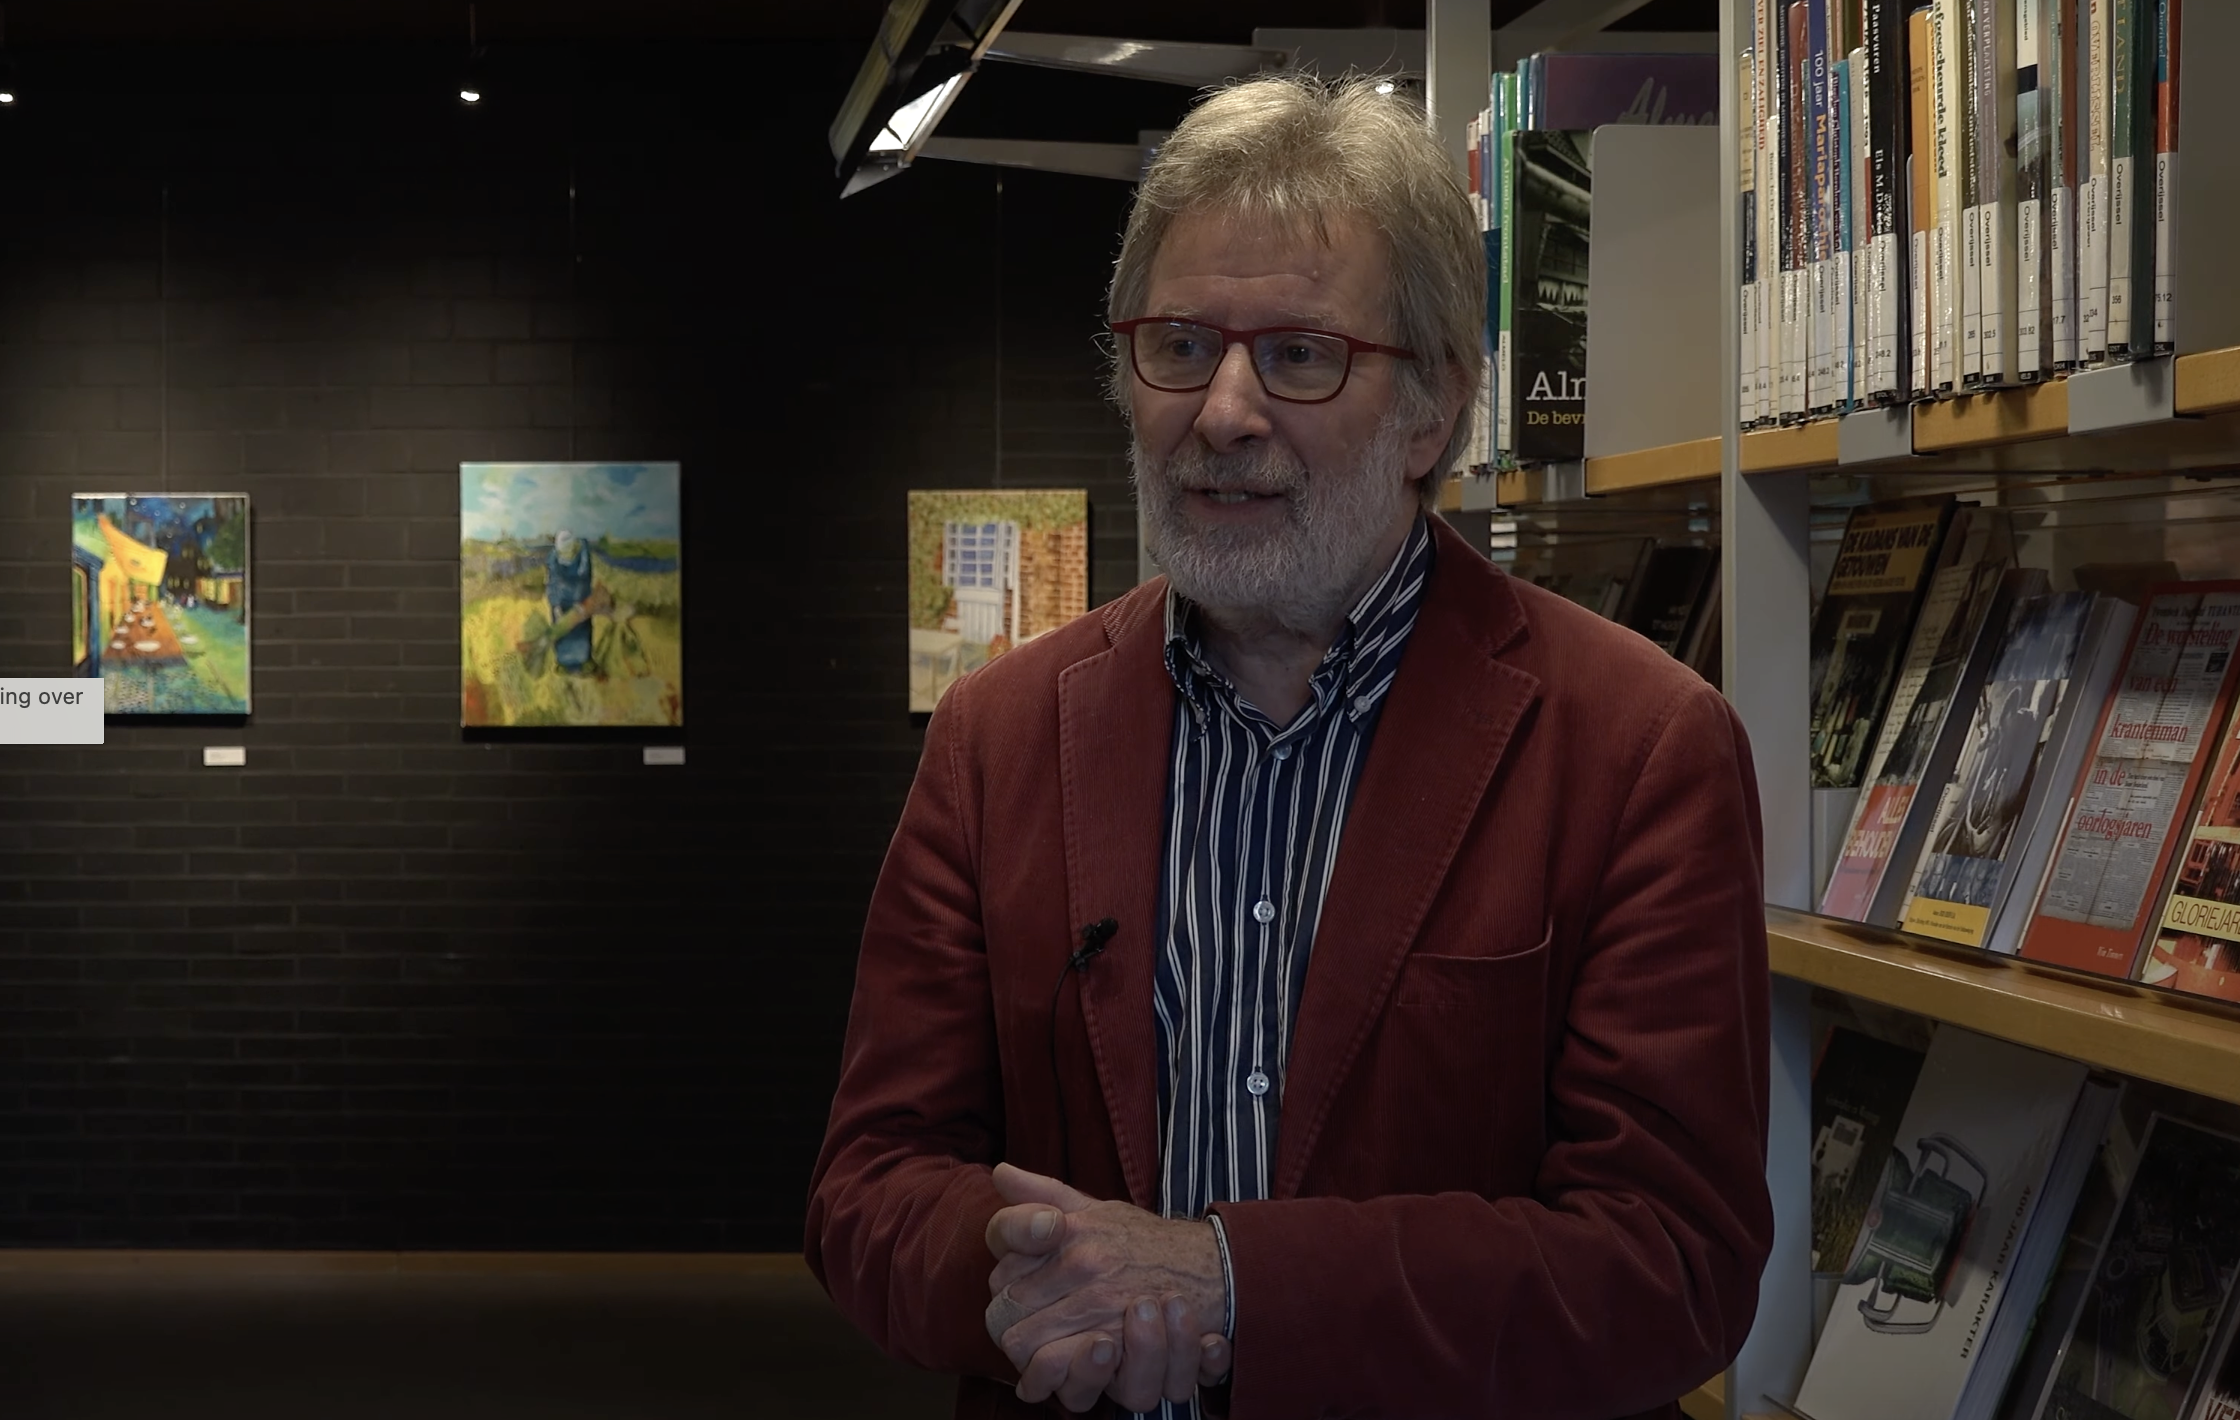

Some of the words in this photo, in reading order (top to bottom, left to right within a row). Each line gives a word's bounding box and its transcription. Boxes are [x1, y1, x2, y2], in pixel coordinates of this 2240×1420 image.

[1871, 4, 1881, 74] Paasvuren
[1982, 16, 1992, 97] VERPLAATSING
[2115, 16, 2126, 95] LAND
[2157, 1, 2167, 58] Overijssel
[1814, 49, 1825, 77] 100
[1933, 1, 1947, 124] afgescheurde
[1812, 80, 1825, 108] jaar
[1874, 148, 1885, 171] Els
[1938, 127, 1948, 178] kleed
[1502, 157, 1511, 211] Almelo
[1814, 113, 1832, 262] Mariaparochie
[2089, 178, 2098, 232] Overijssel
[2115, 163, 2124, 225] Overijssel
[2157, 160, 2166, 223] Overijssel
[1501, 213, 1510, 284] frontstad
[1967, 211, 1976, 268] Overijssel
[1983, 210, 1992, 267] Overijssel
[2022, 205, 2031, 262] Overijssel
[2050, 193, 2060, 250] Overijssel
[1818, 265, 1826, 314] Overijssel
[1878, 240, 1887, 292] Overijssel
[1526, 409, 1549, 425] De
[2142, 621, 2164, 646] De
[2166, 620, 2234, 650] worsteling
[2130, 676, 2152, 692] van
[2154, 677, 2179, 693] een
[2110, 714, 2188, 742] krantenman
[2094, 763, 2108, 785] in
[2109, 762, 2126, 786] de
[2077, 807, 2152, 841] oorlogsjaren
[2015, 1184, 2031, 1218] 400
[1996, 1219, 2017, 1265] JAAR
[1960, 1270, 1999, 1360] KARAKTER
